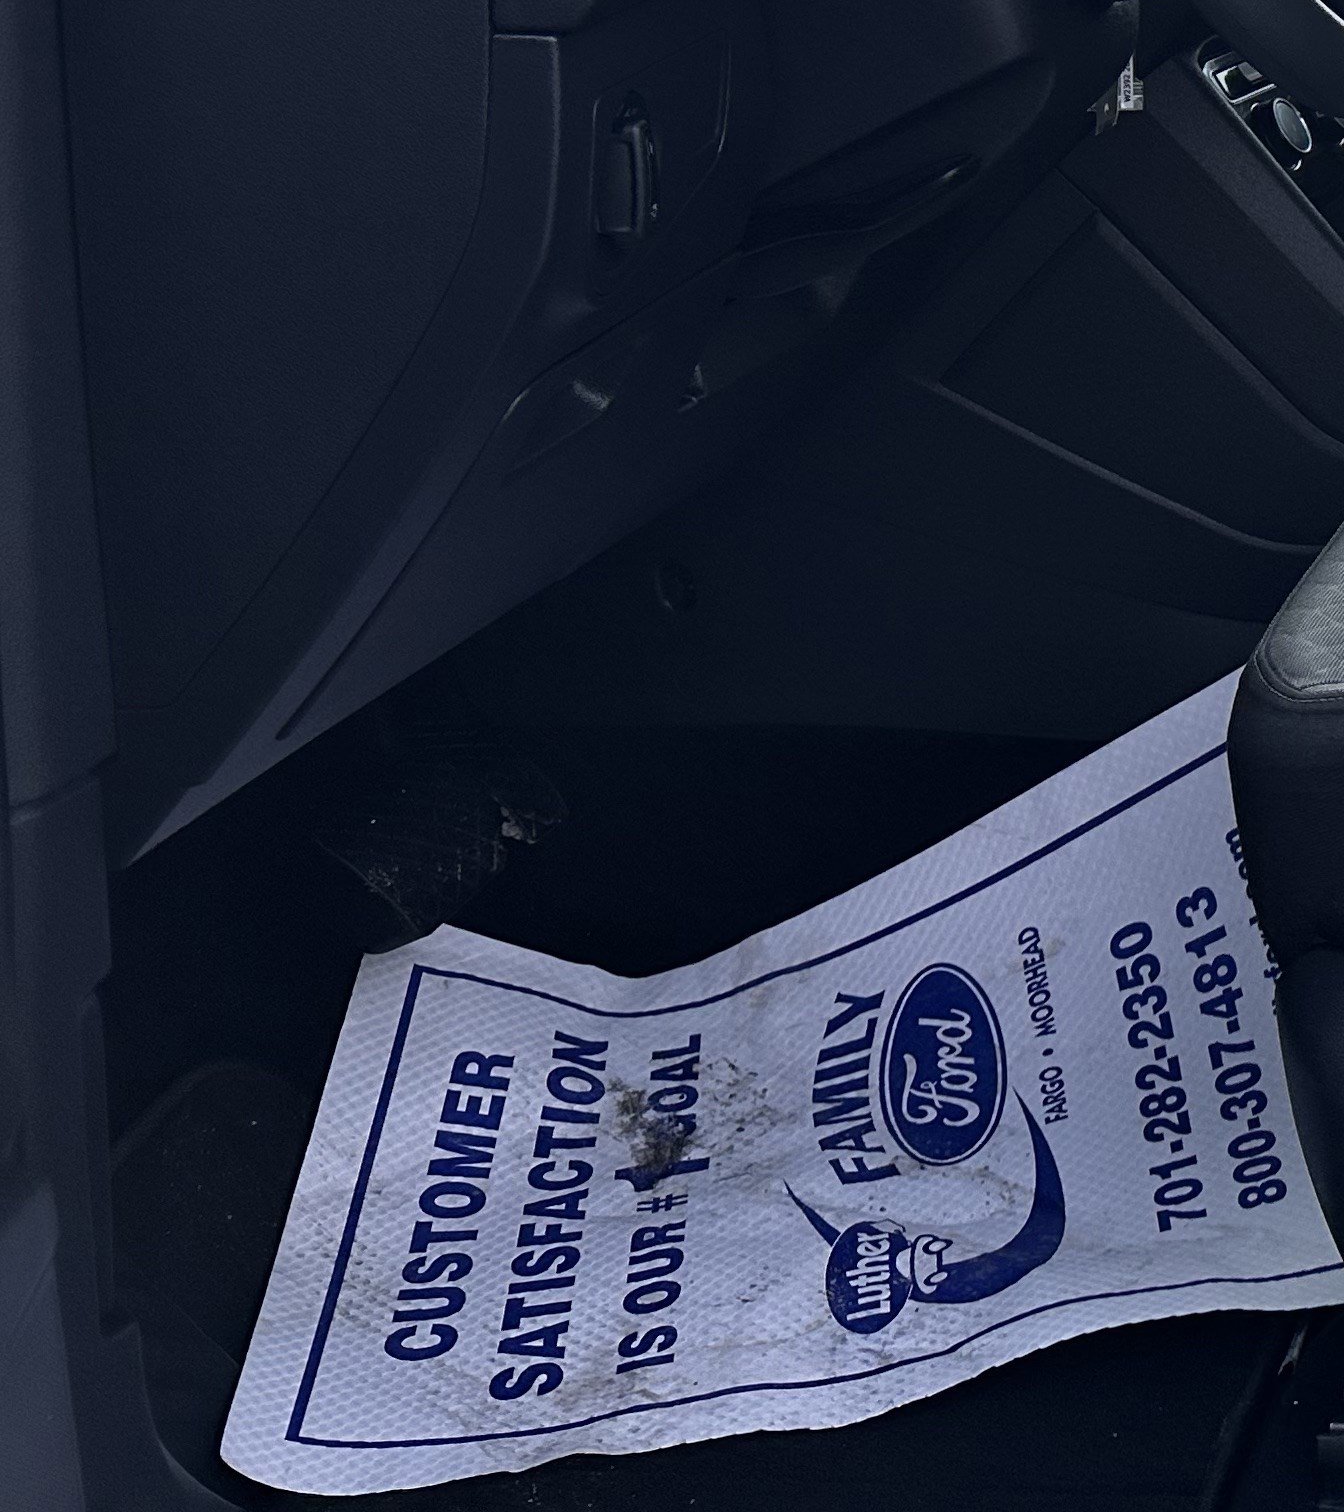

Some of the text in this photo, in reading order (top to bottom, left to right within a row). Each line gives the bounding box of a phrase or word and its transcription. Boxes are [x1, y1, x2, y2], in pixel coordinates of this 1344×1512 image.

[812, 989, 900, 1186] FAMILY
[902, 1008, 979, 1127] Ford
[1019, 926, 1069, 1125] FARGO MOORHEAD
[1110, 921, 1207, 1232] 701-282-2350
[1176, 886, 1287, 1209] 800-307-4813
[384, 1050, 515, 1361] CUSTOMER
[488, 1030, 609, 1401] SATISFACTION
[622, 1219, 687, 1315] OUR
[846, 1231, 890, 1322] Luther
[616, 1325, 678, 1374] IS
